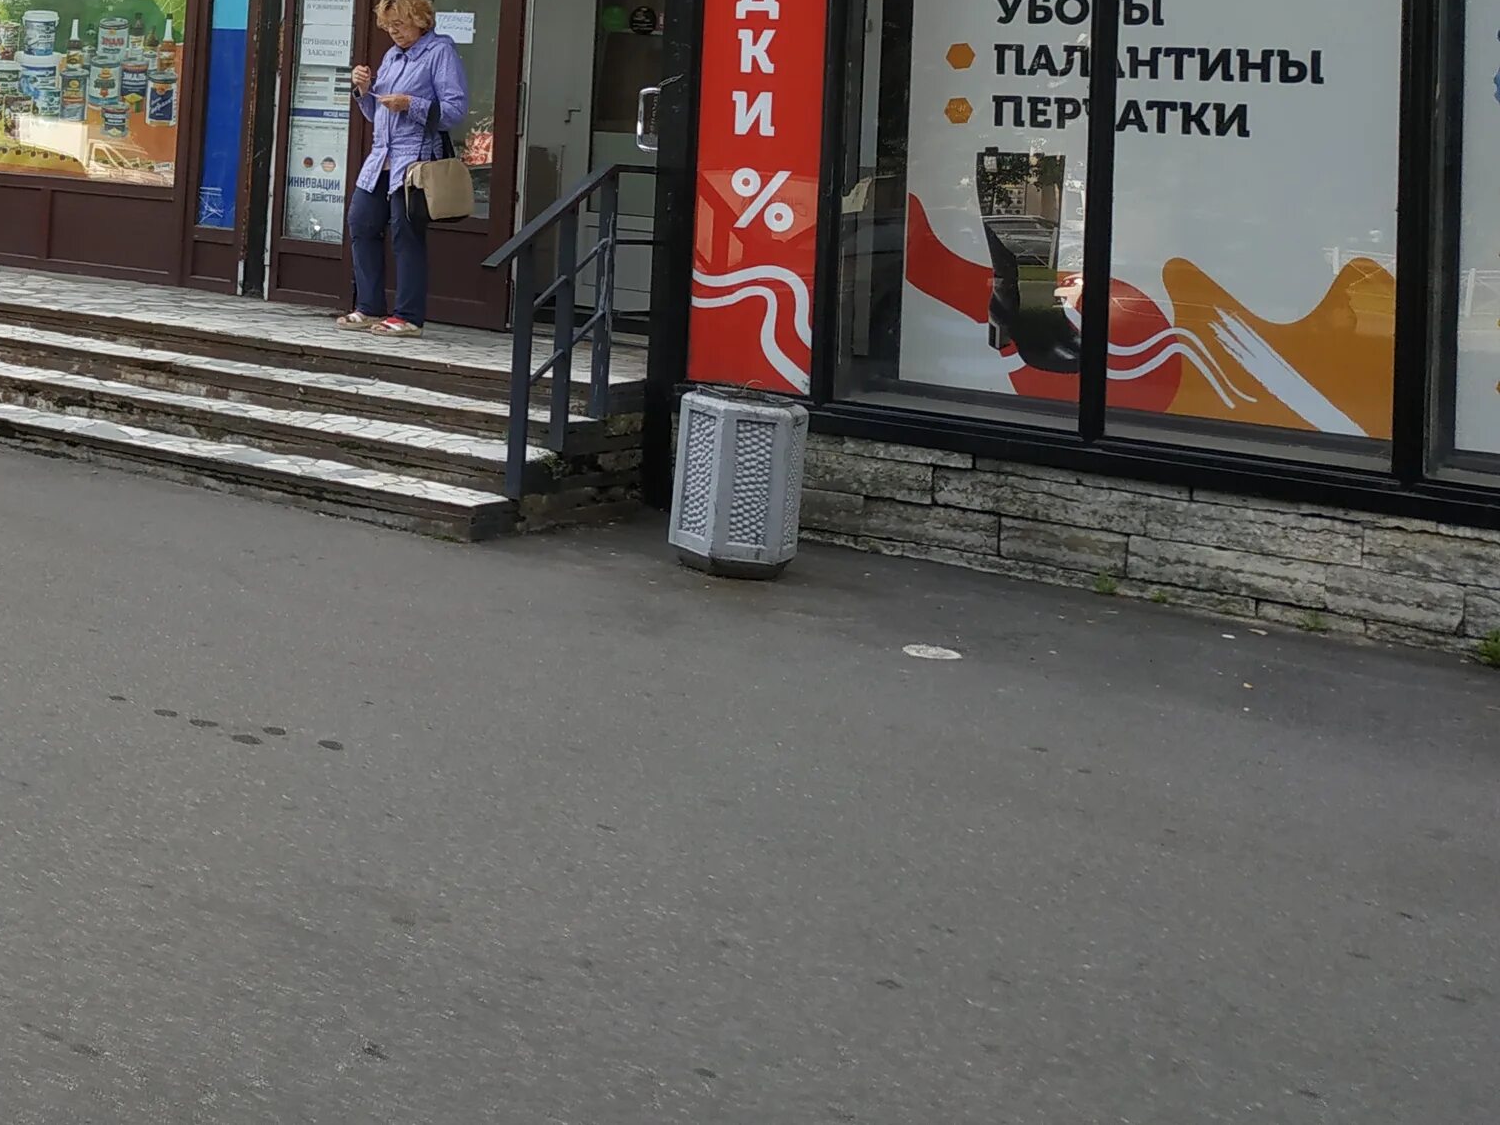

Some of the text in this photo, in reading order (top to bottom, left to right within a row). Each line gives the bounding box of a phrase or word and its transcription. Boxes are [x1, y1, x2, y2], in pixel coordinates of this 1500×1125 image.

[992, 95, 1251, 138] ПЕРАТКИ
[288, 176, 341, 191] ИННОВАЦИИ
[731, 167, 794, 233] %
